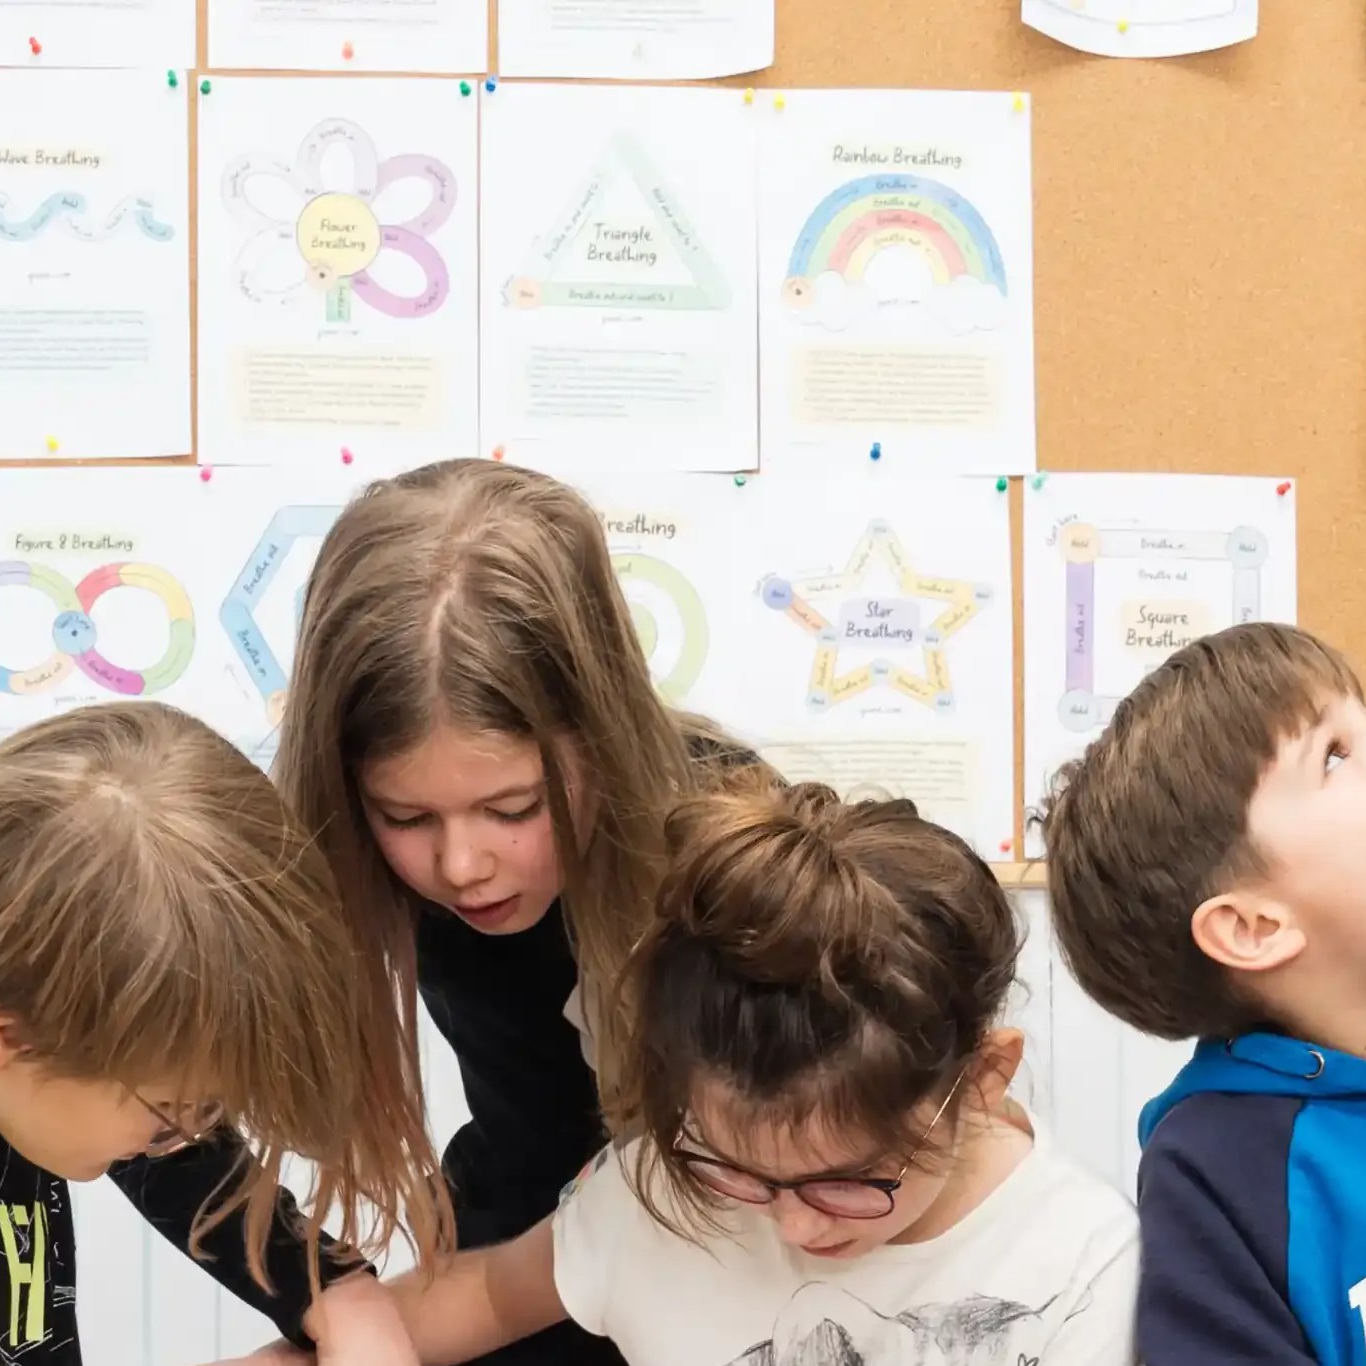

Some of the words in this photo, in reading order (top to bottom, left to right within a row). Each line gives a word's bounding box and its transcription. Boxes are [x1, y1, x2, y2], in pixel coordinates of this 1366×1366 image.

[35, 150, 100, 169] Breathing
[832, 145, 889, 165] Rainbow
[892, 147, 963, 169] Breathing
[319, 218, 358, 234] Flower
[593, 222, 653, 244] Triangle
[310, 235, 366, 252] Breathing
[586, 243, 658, 267] Breathing
[15, 532, 55, 552] Figure
[58, 533, 68, 549] 8
[71, 533, 135, 551] Breathing
[864, 600, 895, 619] Star
[1136, 604, 1190, 630] Square
[845, 620, 914, 642] Breathing
